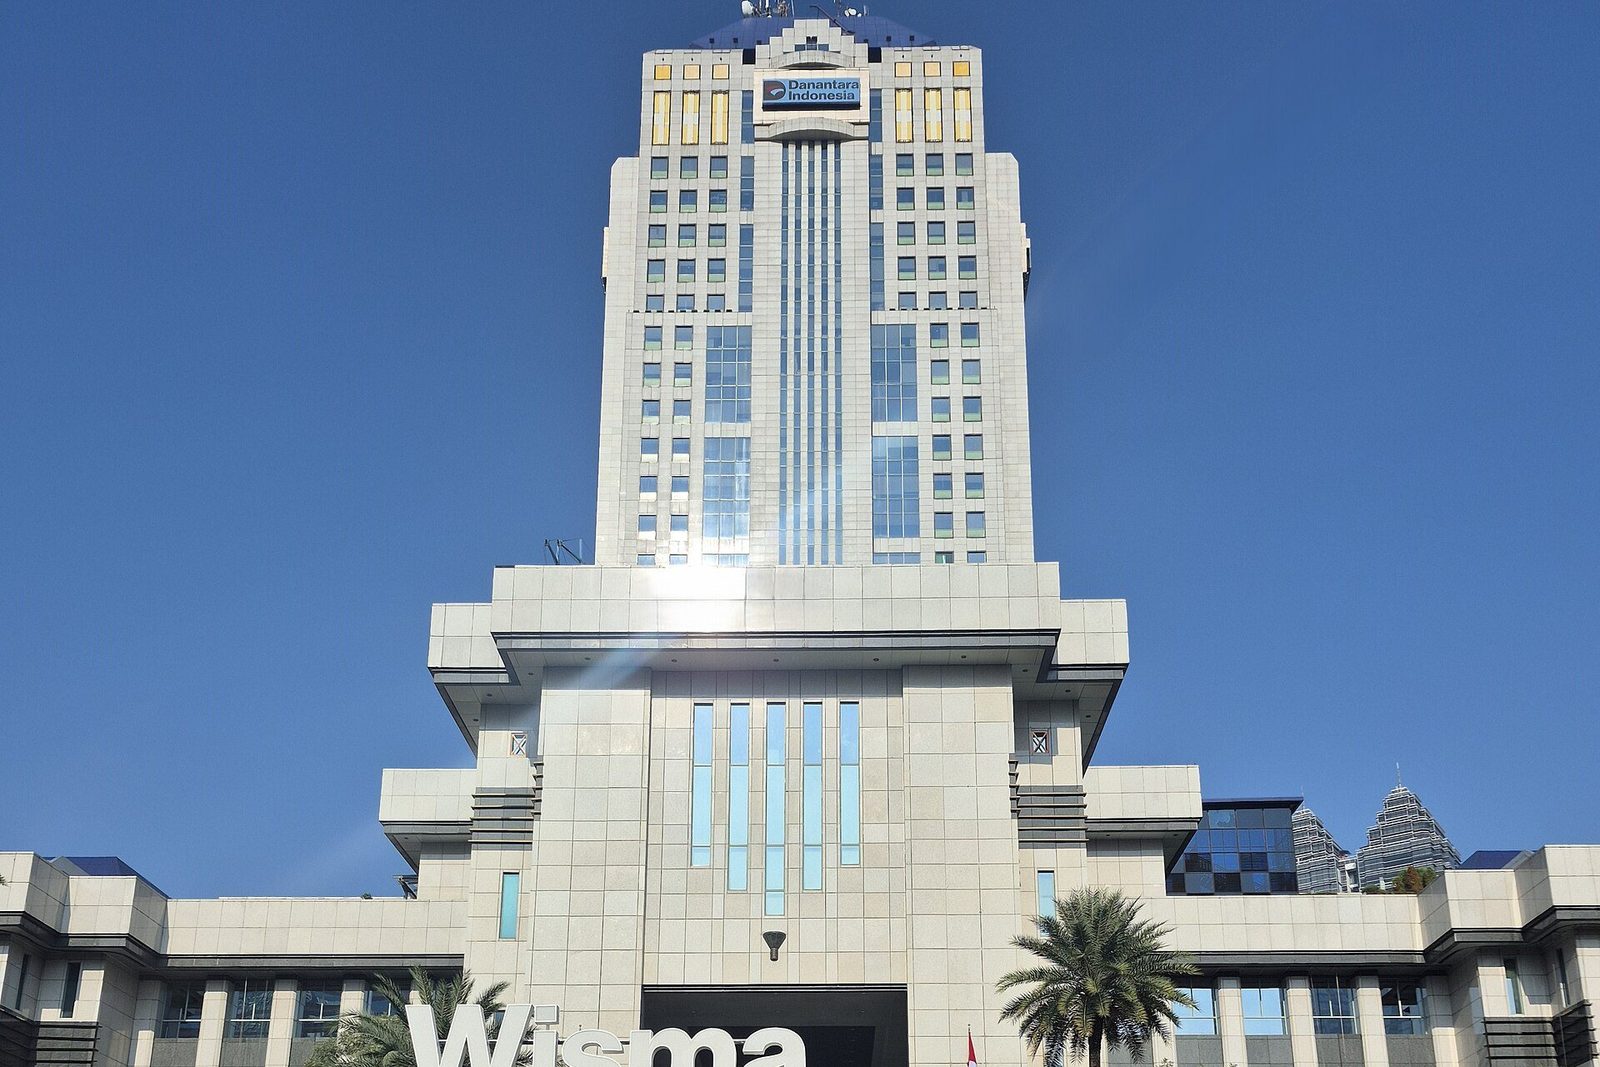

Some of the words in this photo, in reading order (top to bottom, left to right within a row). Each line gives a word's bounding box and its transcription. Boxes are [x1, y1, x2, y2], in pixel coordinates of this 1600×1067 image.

[788, 80, 859, 90] Danantara
[788, 90, 855, 100] Indonesia
[405, 1003, 807, 1067] Wisma
